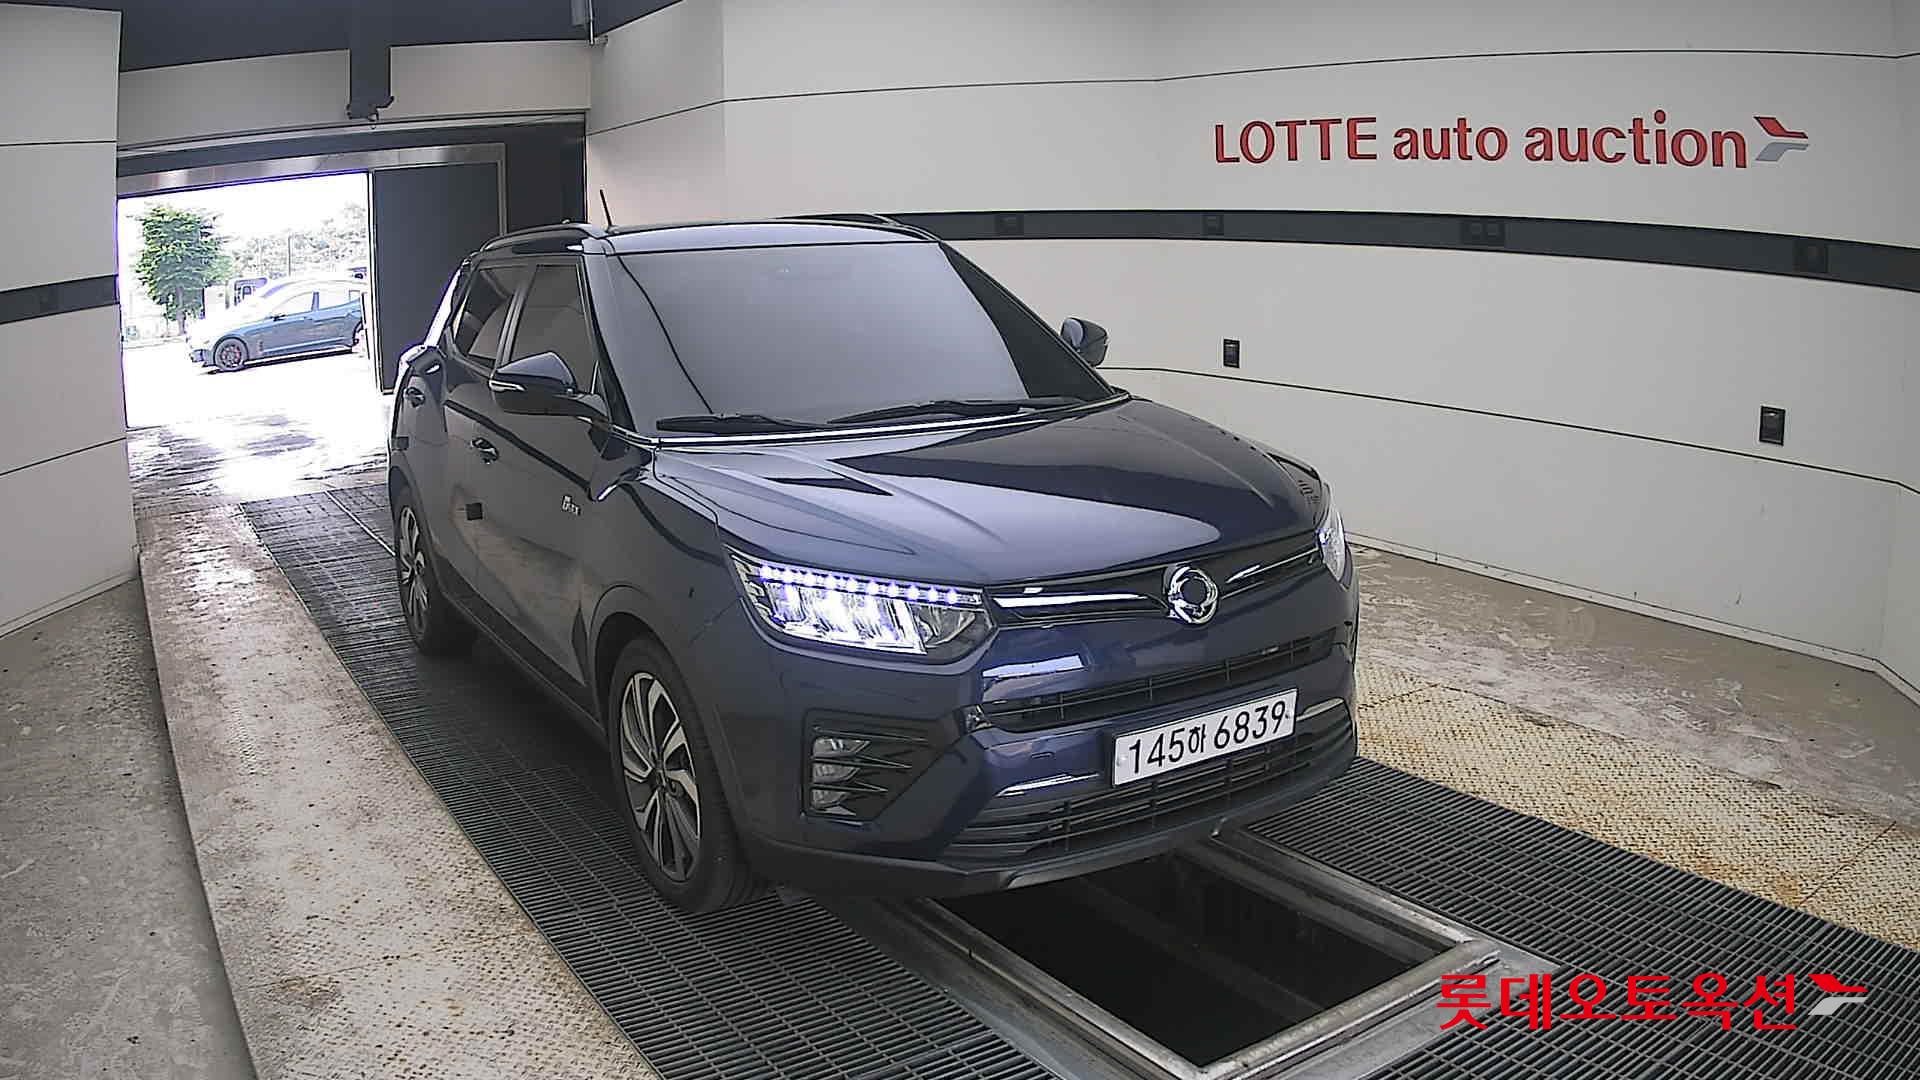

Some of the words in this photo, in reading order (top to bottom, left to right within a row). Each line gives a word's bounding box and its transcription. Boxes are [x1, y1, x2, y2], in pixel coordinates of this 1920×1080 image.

[1214, 117, 1377, 164] LOTTE
[1393, 117, 1508, 162] auto
[1524, 109, 1748, 169] auction
[1129, 723, 1206, 774] 145하
[1214, 701, 1286, 750] 6839
